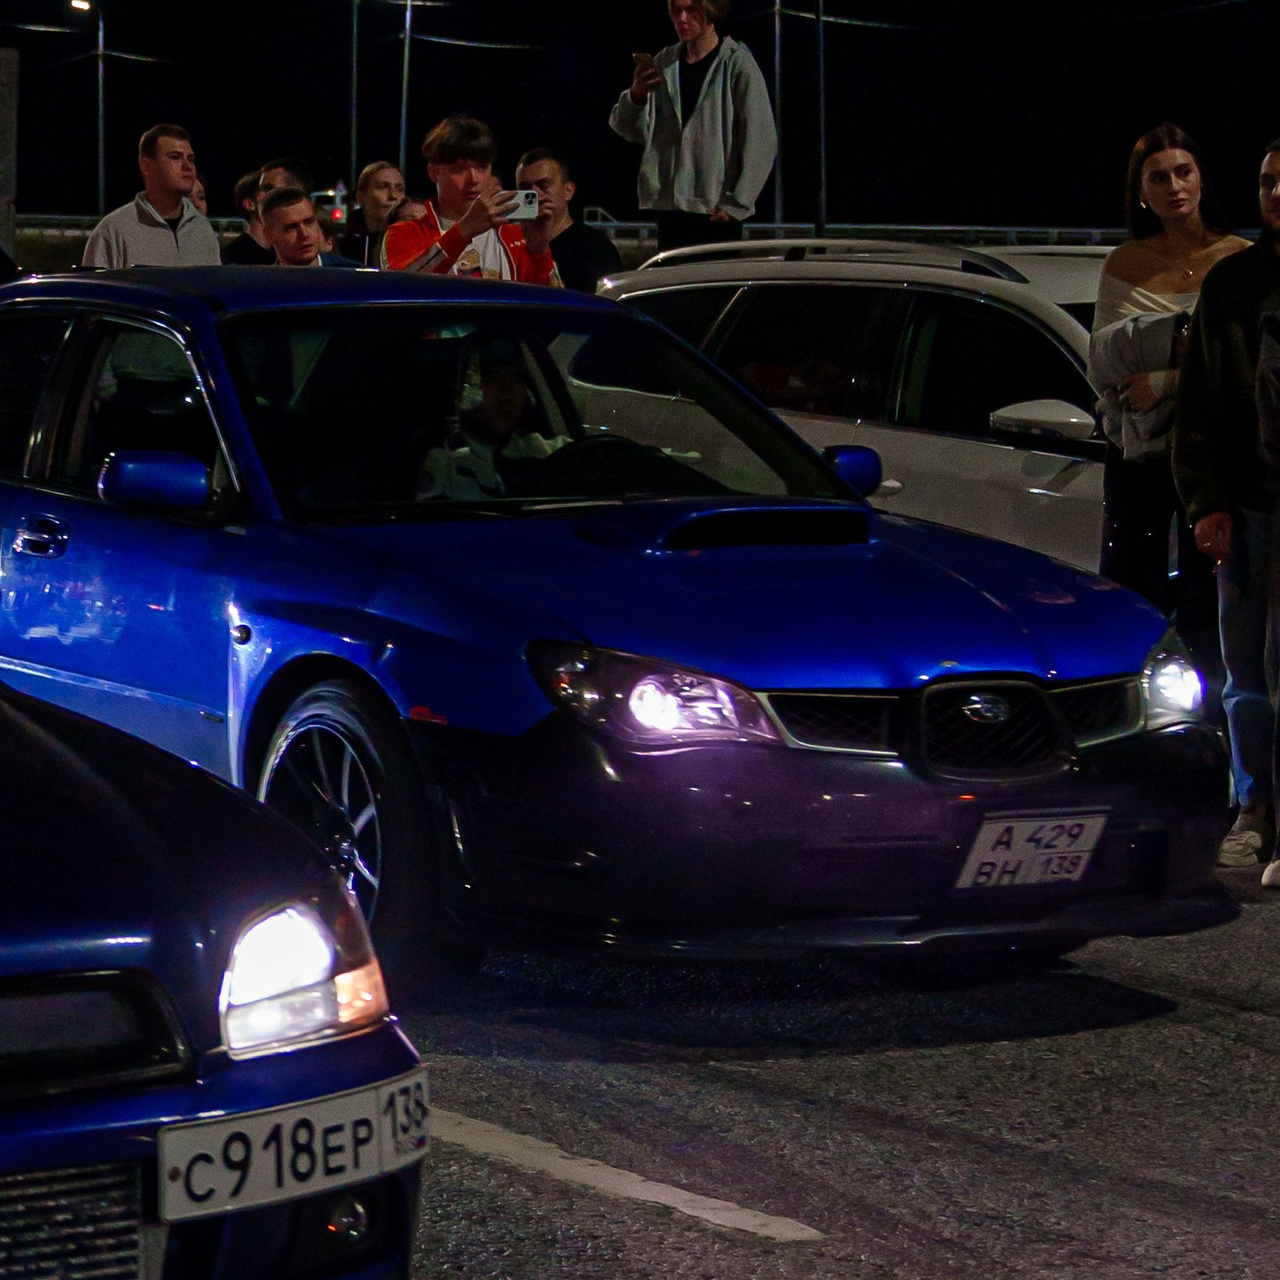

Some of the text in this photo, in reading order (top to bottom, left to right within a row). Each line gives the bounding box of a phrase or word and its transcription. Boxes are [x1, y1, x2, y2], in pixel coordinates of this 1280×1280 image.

[990, 822, 1086, 852] А 429
[1041, 854, 1081, 875] 138
